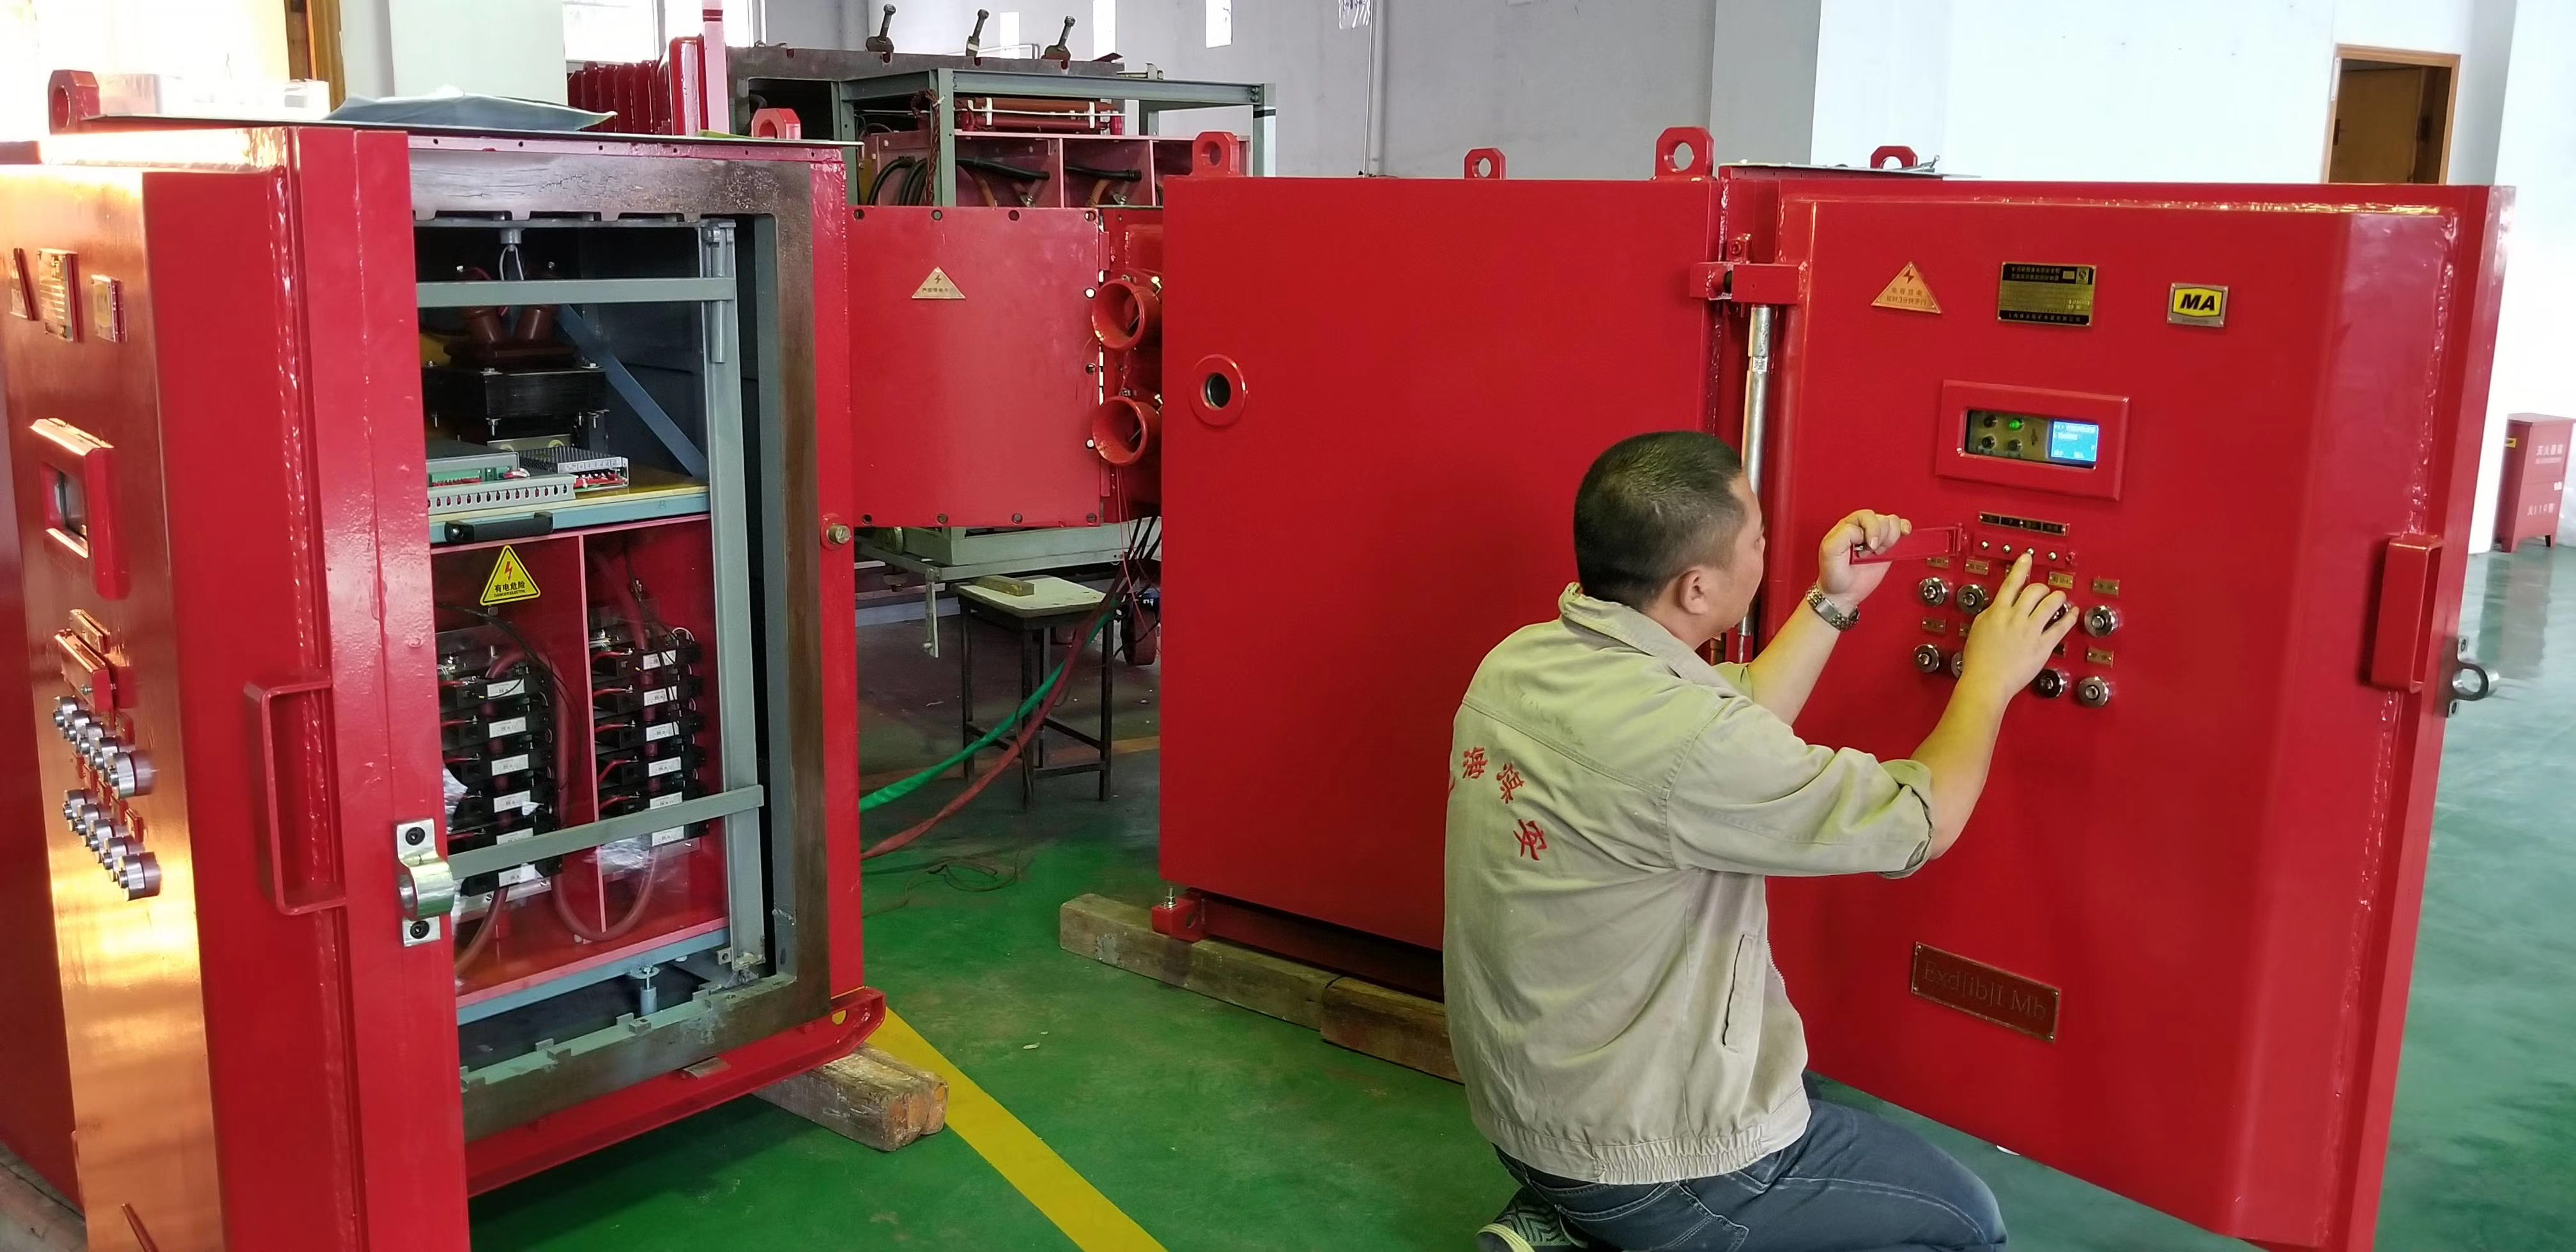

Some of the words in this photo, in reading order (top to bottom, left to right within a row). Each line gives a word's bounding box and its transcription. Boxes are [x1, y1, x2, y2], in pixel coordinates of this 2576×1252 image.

[2179, 293, 2215, 311] MA
[494, 581, 525, 593] 有电危险
[2011, 990, 2046, 1020] Mb
